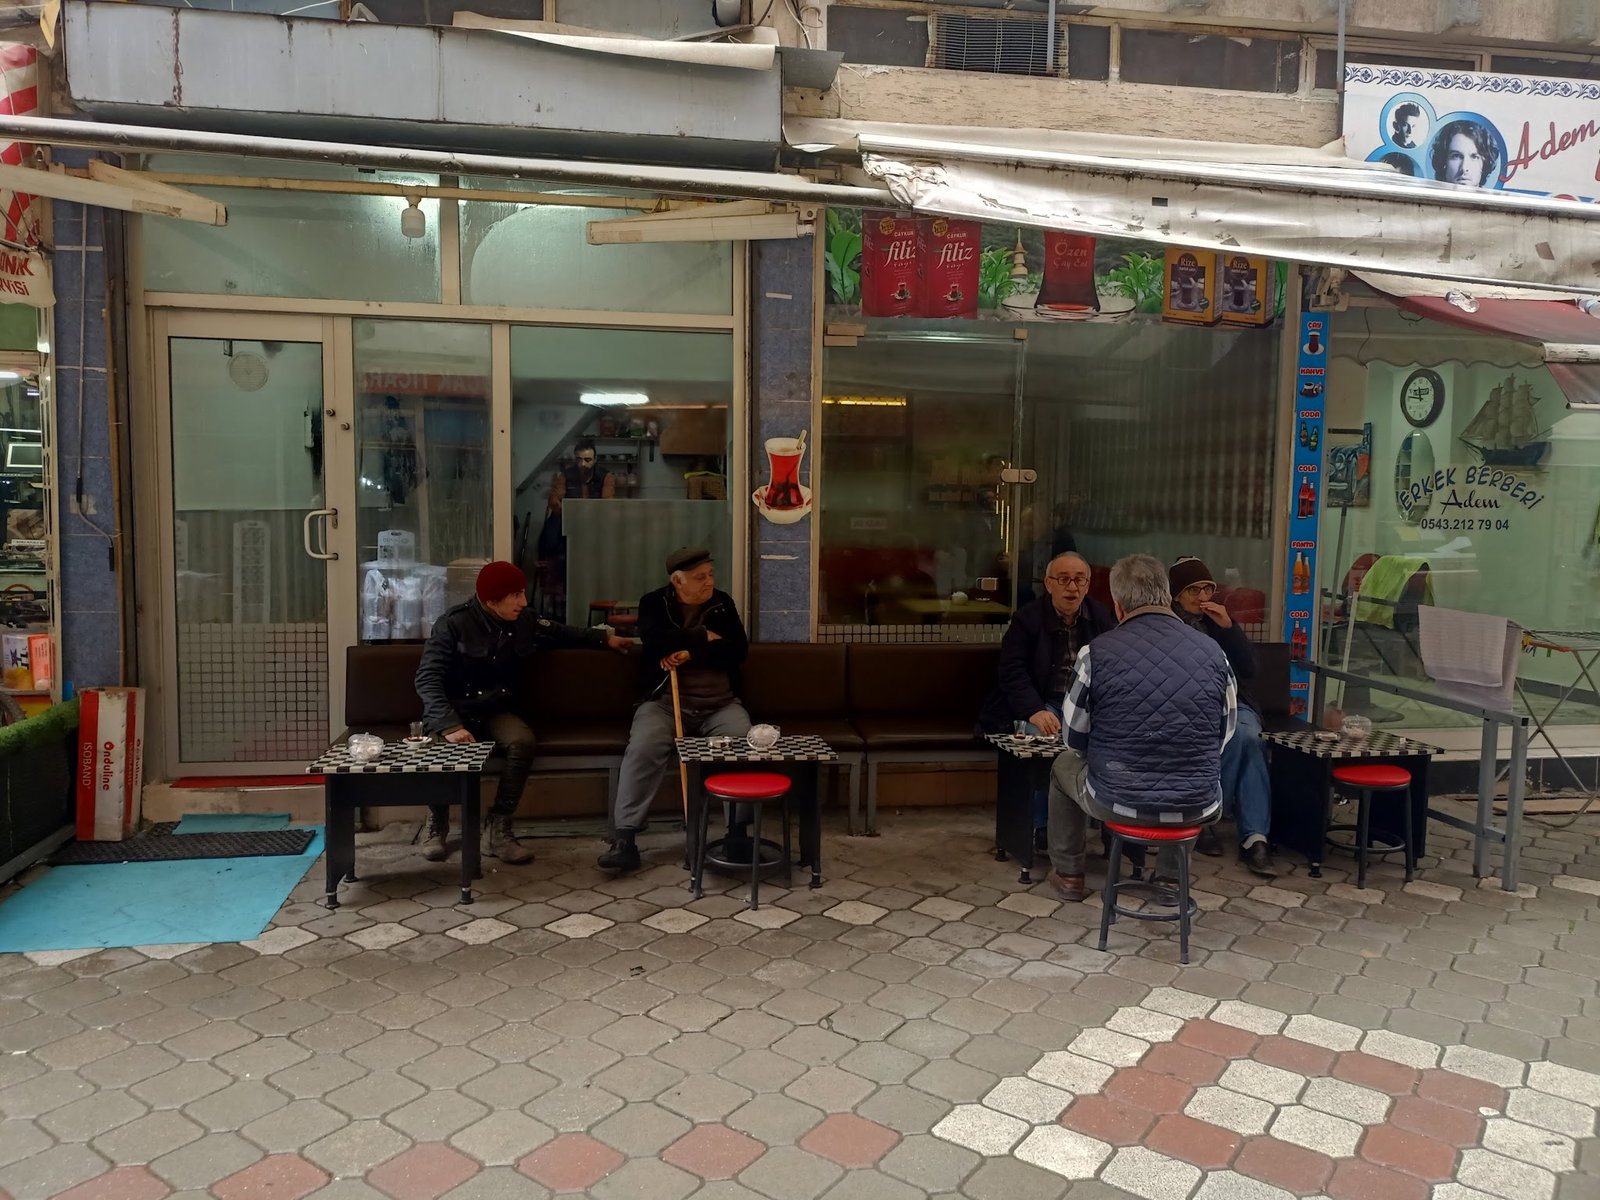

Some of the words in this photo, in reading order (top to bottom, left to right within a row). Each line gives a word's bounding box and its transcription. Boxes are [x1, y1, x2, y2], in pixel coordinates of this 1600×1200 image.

[1498, 119, 1600, 183] Adem
[936, 242, 974, 269] filiz
[1054, 238, 1088, 256] Özen
[1307, 321, 1322, 330] ÇAY
[1400, 467, 1456, 512] ERKEK
[1465, 466, 1545, 511] BERBERİ
[1440, 489, 1501, 515] Adem
[1421, 519, 1474, 530] 0543.212
[1478, 519, 1491, 530] 79
[1495, 519, 1509, 530] 04
[82, 742, 93, 786] ISOBAND
[103, 741, 115, 791] Onduline
